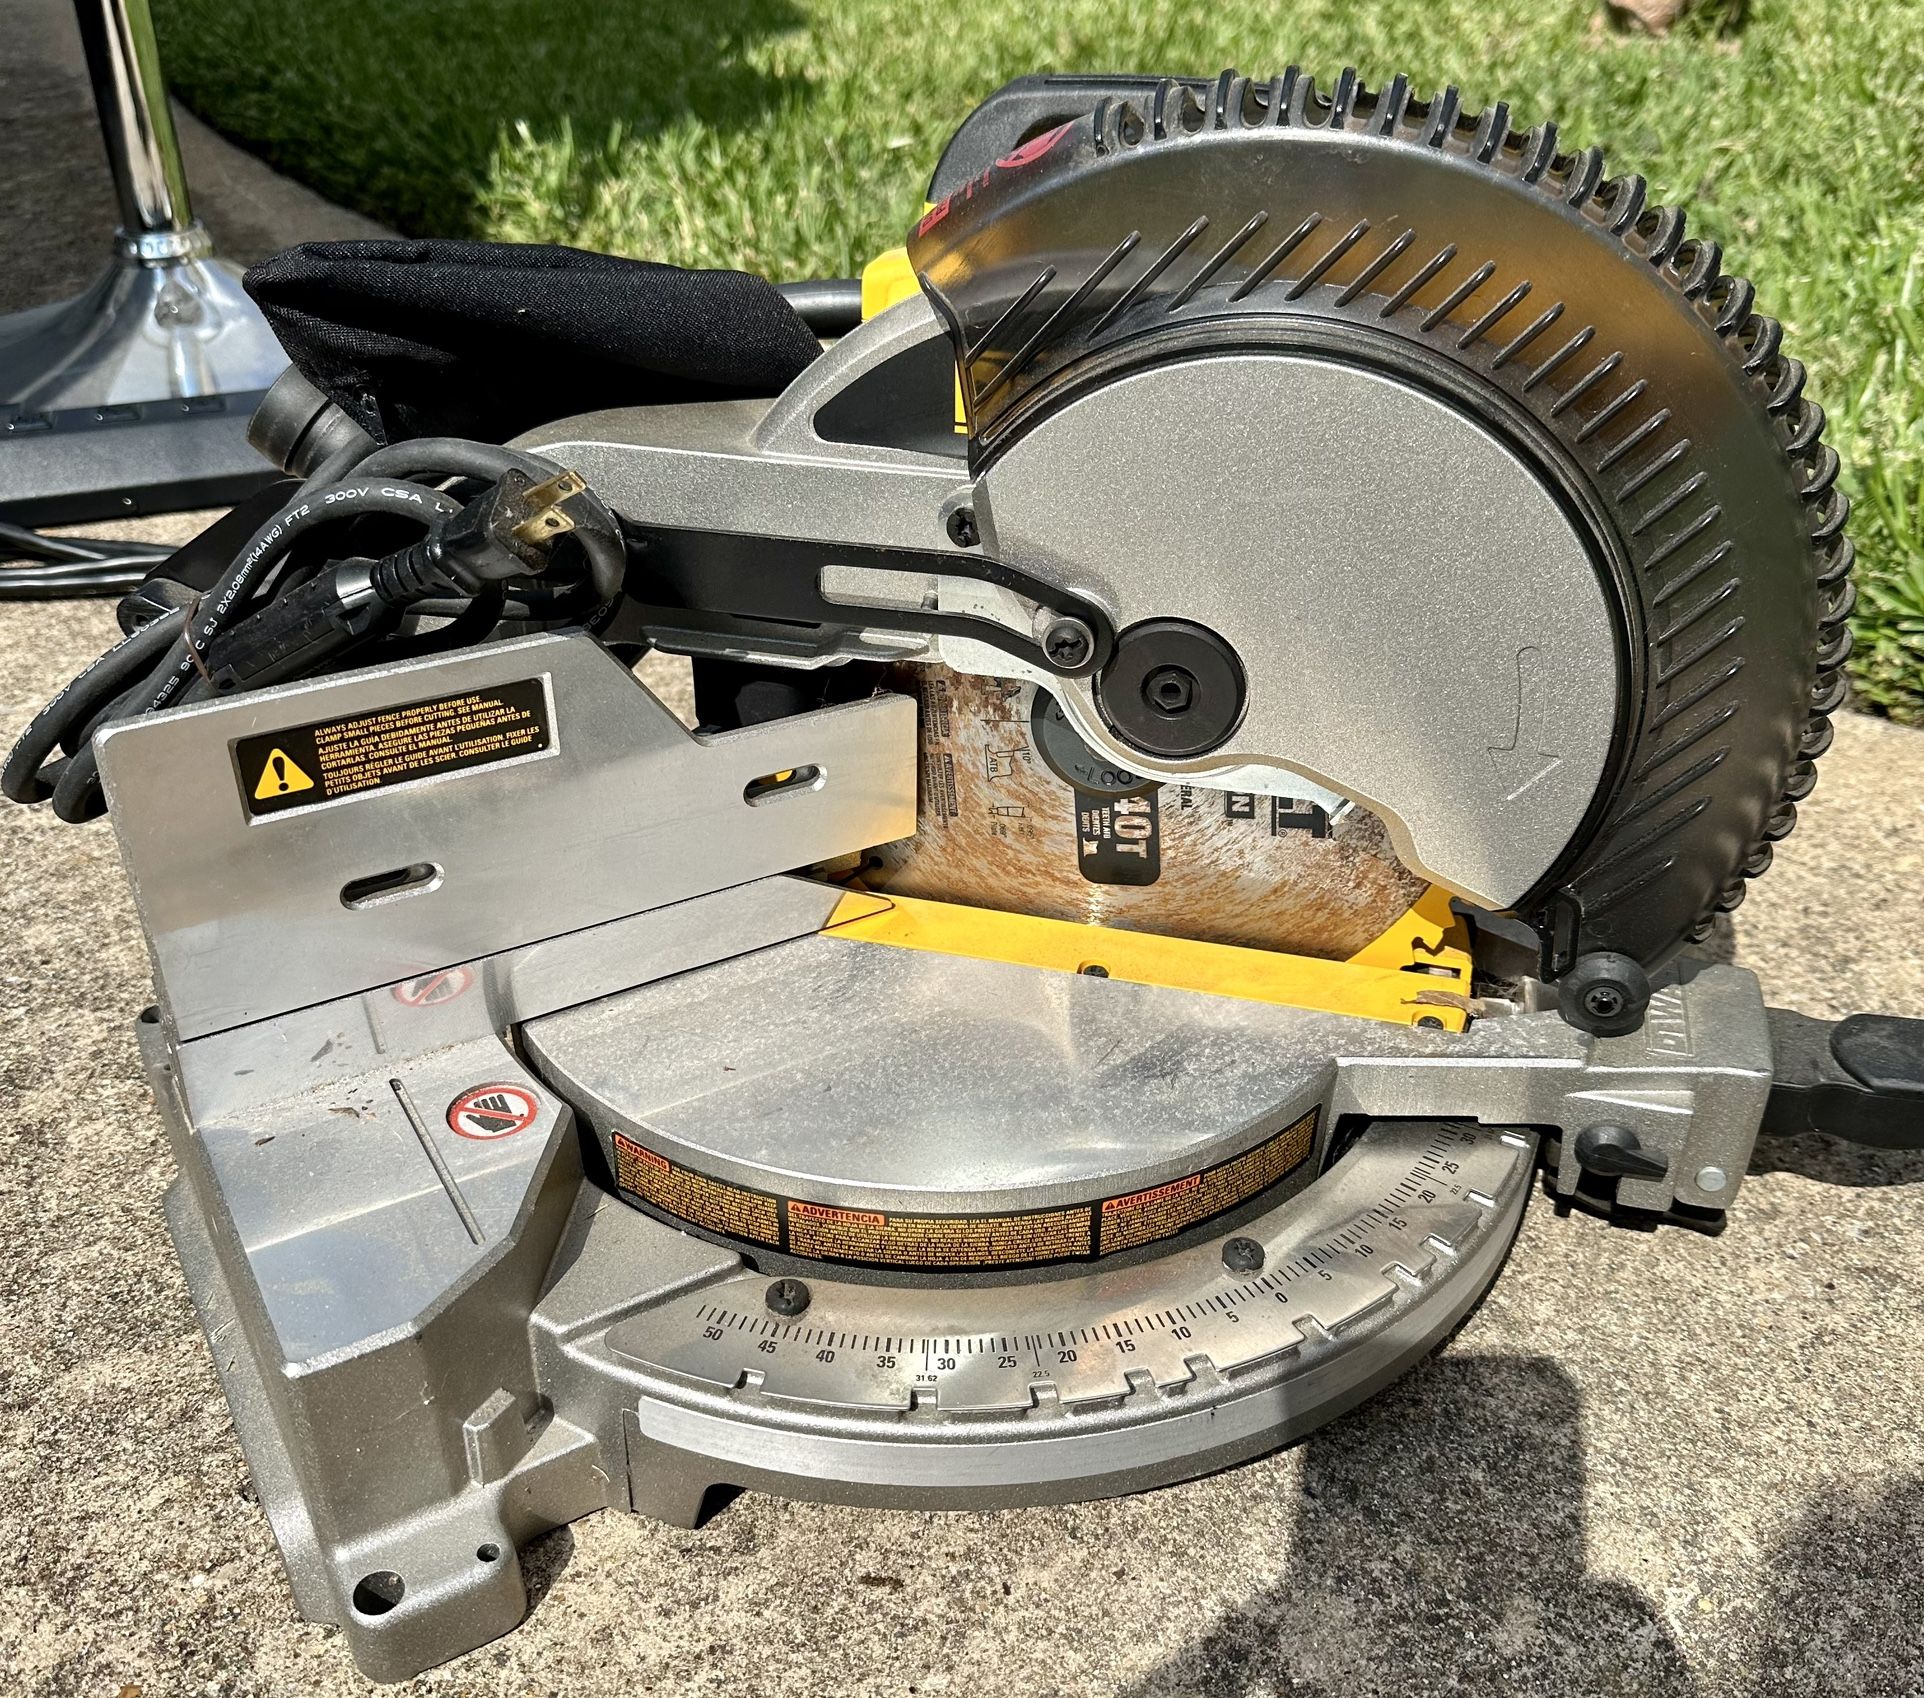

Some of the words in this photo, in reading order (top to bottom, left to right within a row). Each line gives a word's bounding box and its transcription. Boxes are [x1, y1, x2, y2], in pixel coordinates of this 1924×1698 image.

[203, 616, 218, 636] SJ
[284, 504, 311, 527] FT2
[324, 487, 370, 505] 300V
[381, 487, 423, 504] CSA
[314, 723, 346, 736] ALWAYS
[347, 717, 376, 729] ADJUST
[377, 712, 400, 723] FENCE
[401, 704, 438, 718] PROPERLY
[438, 698, 465, 710] BEFORE
[315, 732, 342, 744] CLAMP
[343, 727, 368, 738] SMALL
[369, 721, 394, 733] PIECES
[395, 715, 422, 727] BEFORE
[456, 705, 470, 714] SEE
[317, 741, 347, 754] AJUSTE
[348, 739, 359, 747] LA
[380, 723, 435, 741] DEBIDAMENTE
[435, 717, 460, 729] ANTES
[461, 715, 472, 723] DE
[472, 708, 505, 721] UTILIZAR
[505, 706, 515, 714] LA
[377, 735, 412, 749] ASEGURE
[413, 732, 428, 742] LAS
[429, 726, 455, 738] PIEZAS
[496, 712, 520, 724] ANTES
[521, 710, 531, 718] DE
[322, 764, 364, 779] TOUJOURS
[394, 756, 403, 764] LE
[404, 751, 427, 761] GUIDE
[428, 745, 453, 756] AVANT
[505, 729, 526, 740] FIXER
[526, 726, 539, 735] LES
[368, 745, 407, 759] CONSULTE
[408, 742, 417, 750] EL
[324, 775, 350, 786] PETITS
[351, 768, 381, 780] OBJETS
[382, 762, 407, 774] AVANT
[408, 760, 419, 768] DE
[419, 757, 433, 766] LES
[458, 742, 500, 757] CONSULTER
[510, 736, 532, 746] GUIDE
[989, 757, 998, 773] ATB
[1101, 807, 1111, 826] TEETH
[1114, 796, 1152, 859] 40T
[1460, 1132, 1477, 1145] 30
[624, 1141, 667, 1170] WARNING
[1441, 1160, 1460, 1175] 25
[1116, 1177, 1199, 1208] AVERTISSEMENT
[1417, 1189, 1437, 1204] 20
[802, 1205, 880, 1224] ADVERTENCIA
[1387, 1216, 1408, 1231] 15
[1354, 1243, 1374, 1258] 10
[1320, 1269, 1333, 1282] 5
[1276, 1291, 1289, 1304] 0
[1226, 1310, 1240, 1324] 5
[702, 1326, 723, 1341] 50
[1171, 1325, 1192, 1341] 10
[757, 1339, 778, 1354] 45
[1115, 1338, 1136, 1354] 15
[815, 1349, 836, 1364] 40
[876, 1355, 896, 1369] 35
[936, 1357, 957, 1371] 30
[997, 1355, 1017, 1369] 25
[1057, 1349, 1078, 1364] 20
